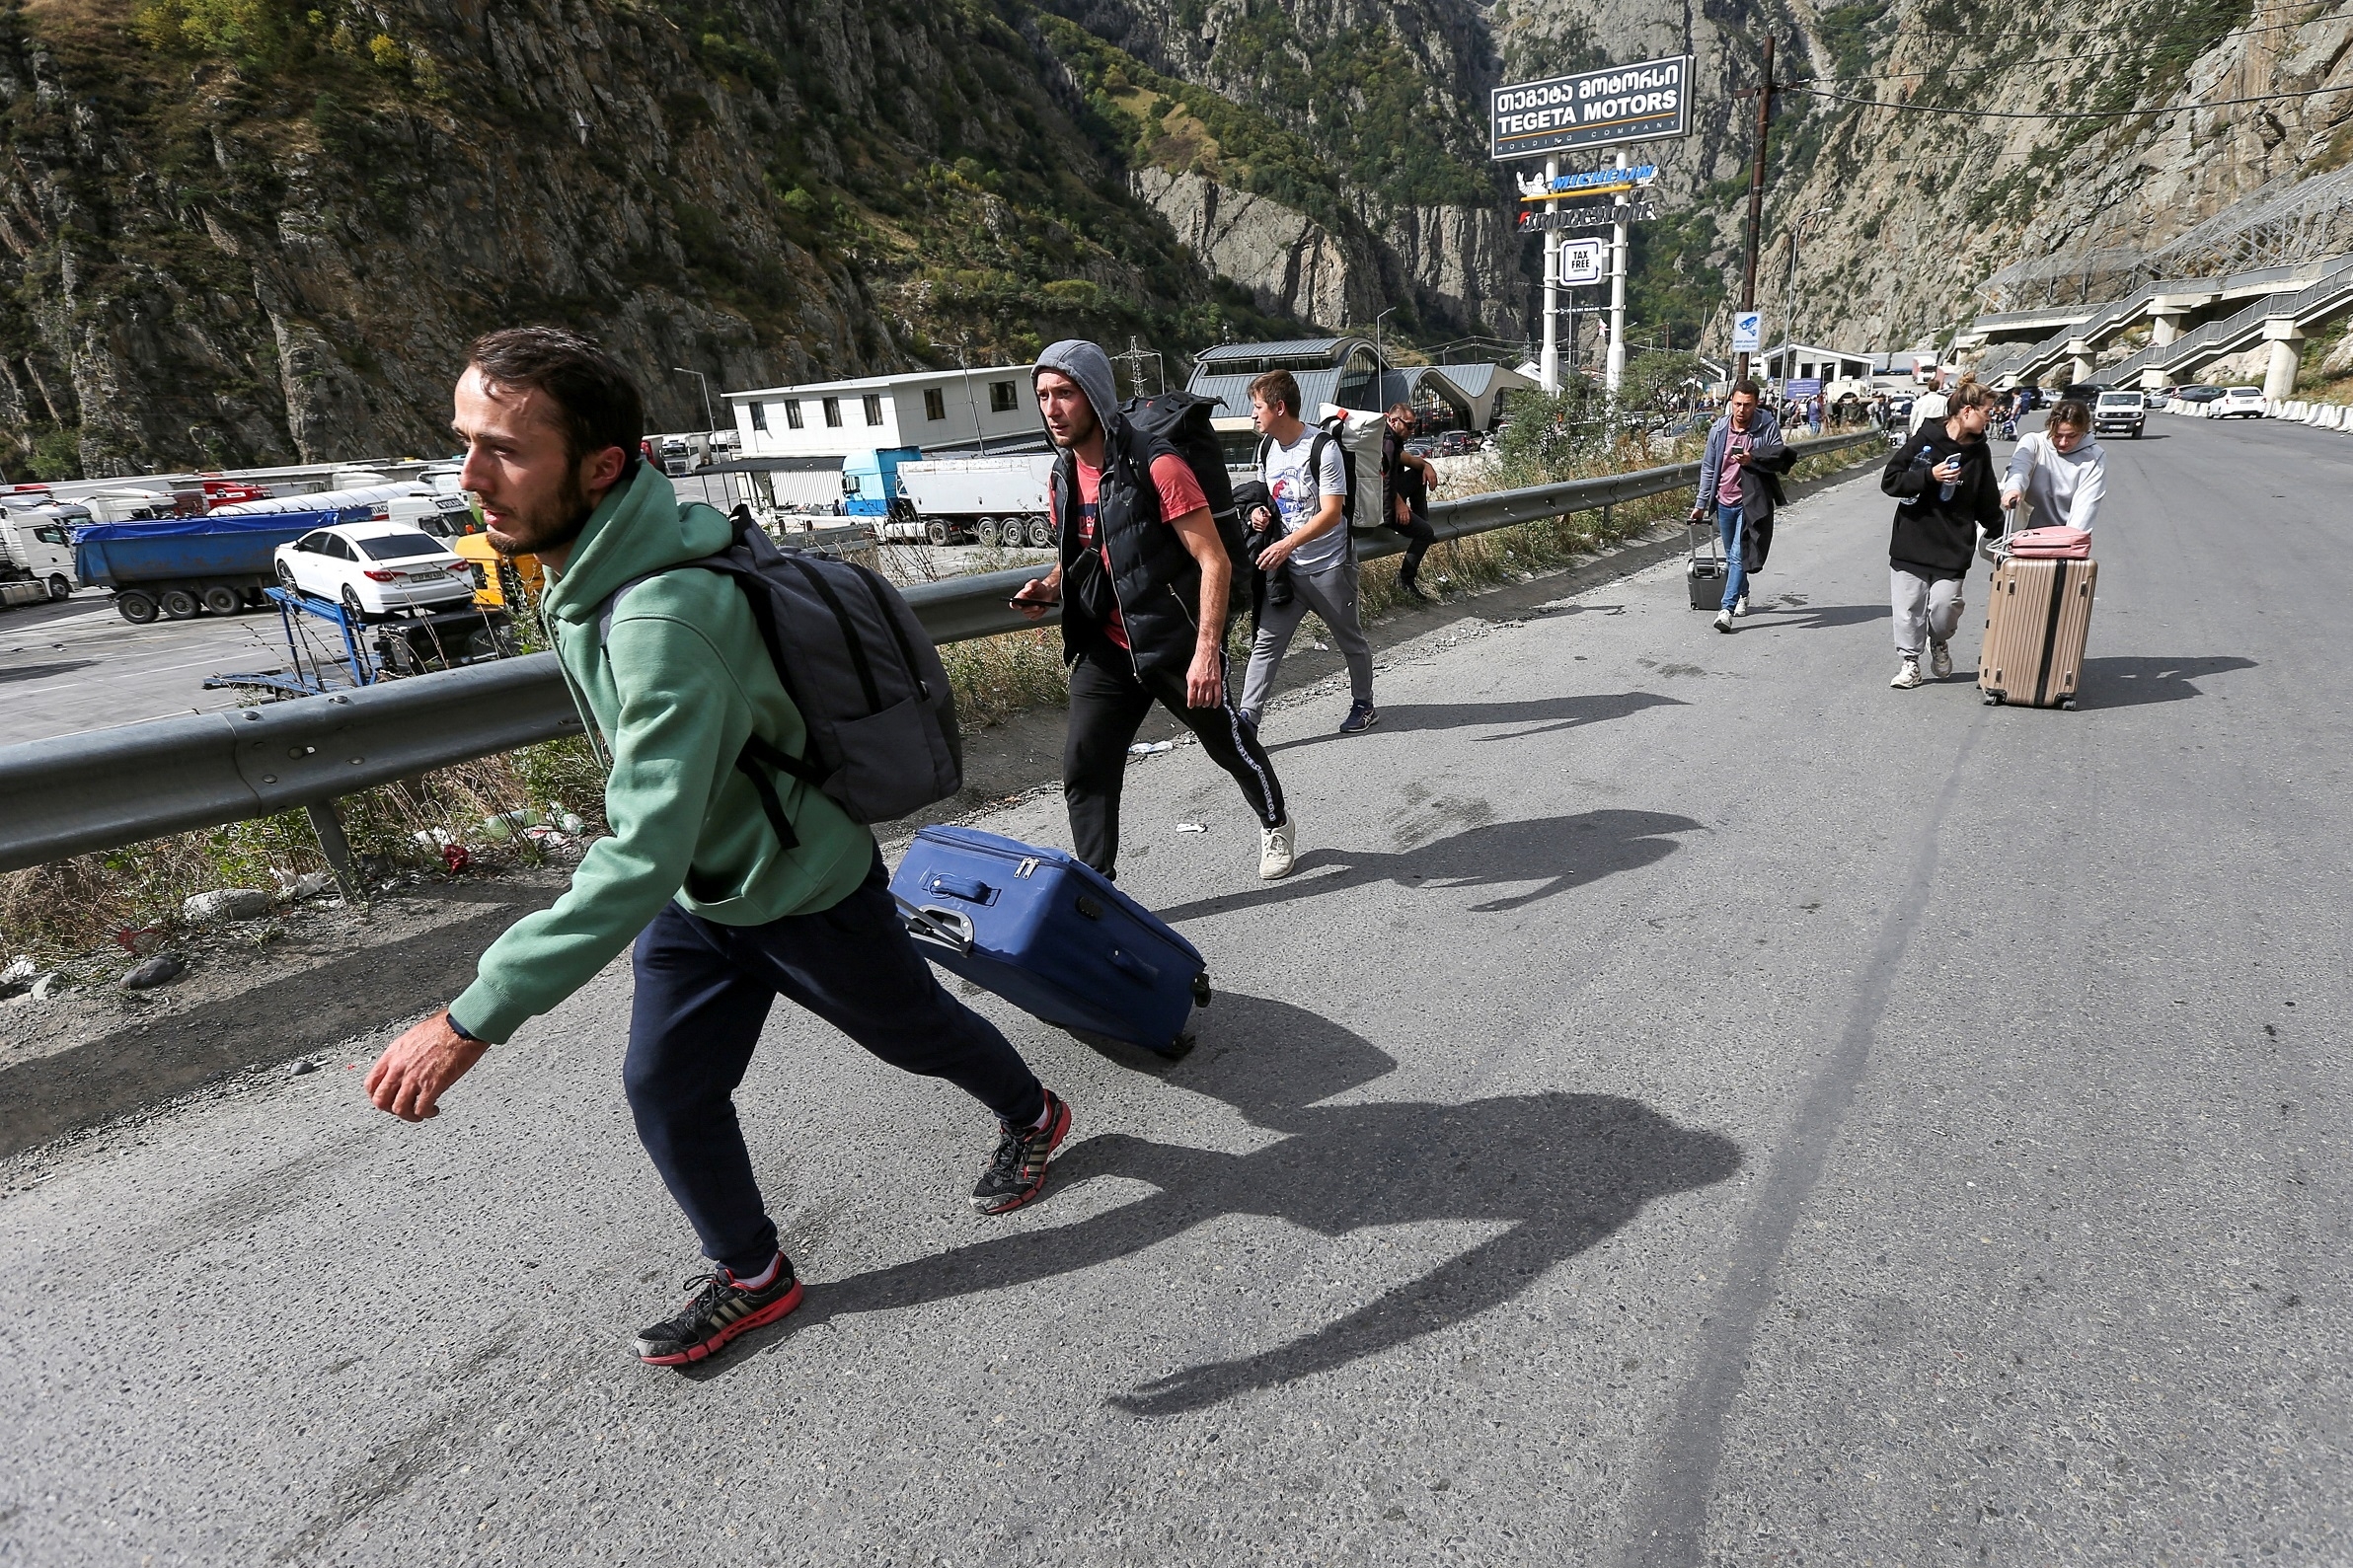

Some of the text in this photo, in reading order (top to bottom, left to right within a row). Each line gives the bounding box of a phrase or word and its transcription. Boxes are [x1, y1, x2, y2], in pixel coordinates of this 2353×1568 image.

[1497, 64, 1679, 112] თეგეტა მოტორსი
[1497, 90, 1678, 134] TEGETA MOTORS
[1497, 119, 1676, 151] HOLDING COMPANY
[1551, 164, 1655, 189] MICHELIN
[1571, 260, 1590, 268] FREE
[1573, 251, 1588, 260] TAX
